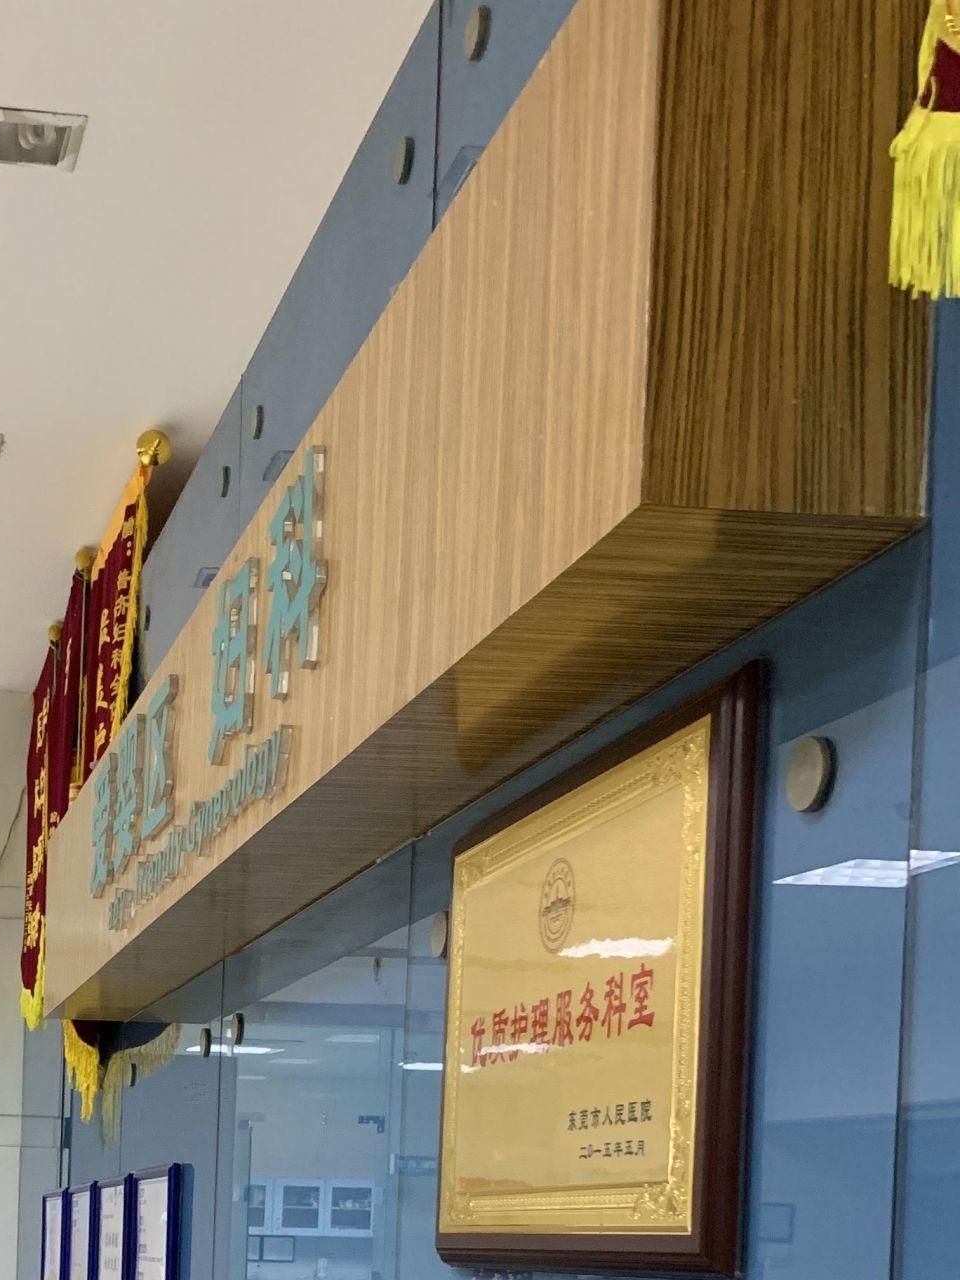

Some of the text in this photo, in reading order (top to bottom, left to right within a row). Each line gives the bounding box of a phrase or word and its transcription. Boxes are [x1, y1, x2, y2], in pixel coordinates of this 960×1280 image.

[207, 446, 324, 765] 妇科
[471, 962, 655, 1068] 优质护理服务科室
[567, 1098, 653, 1131] 东莞市人民医院
